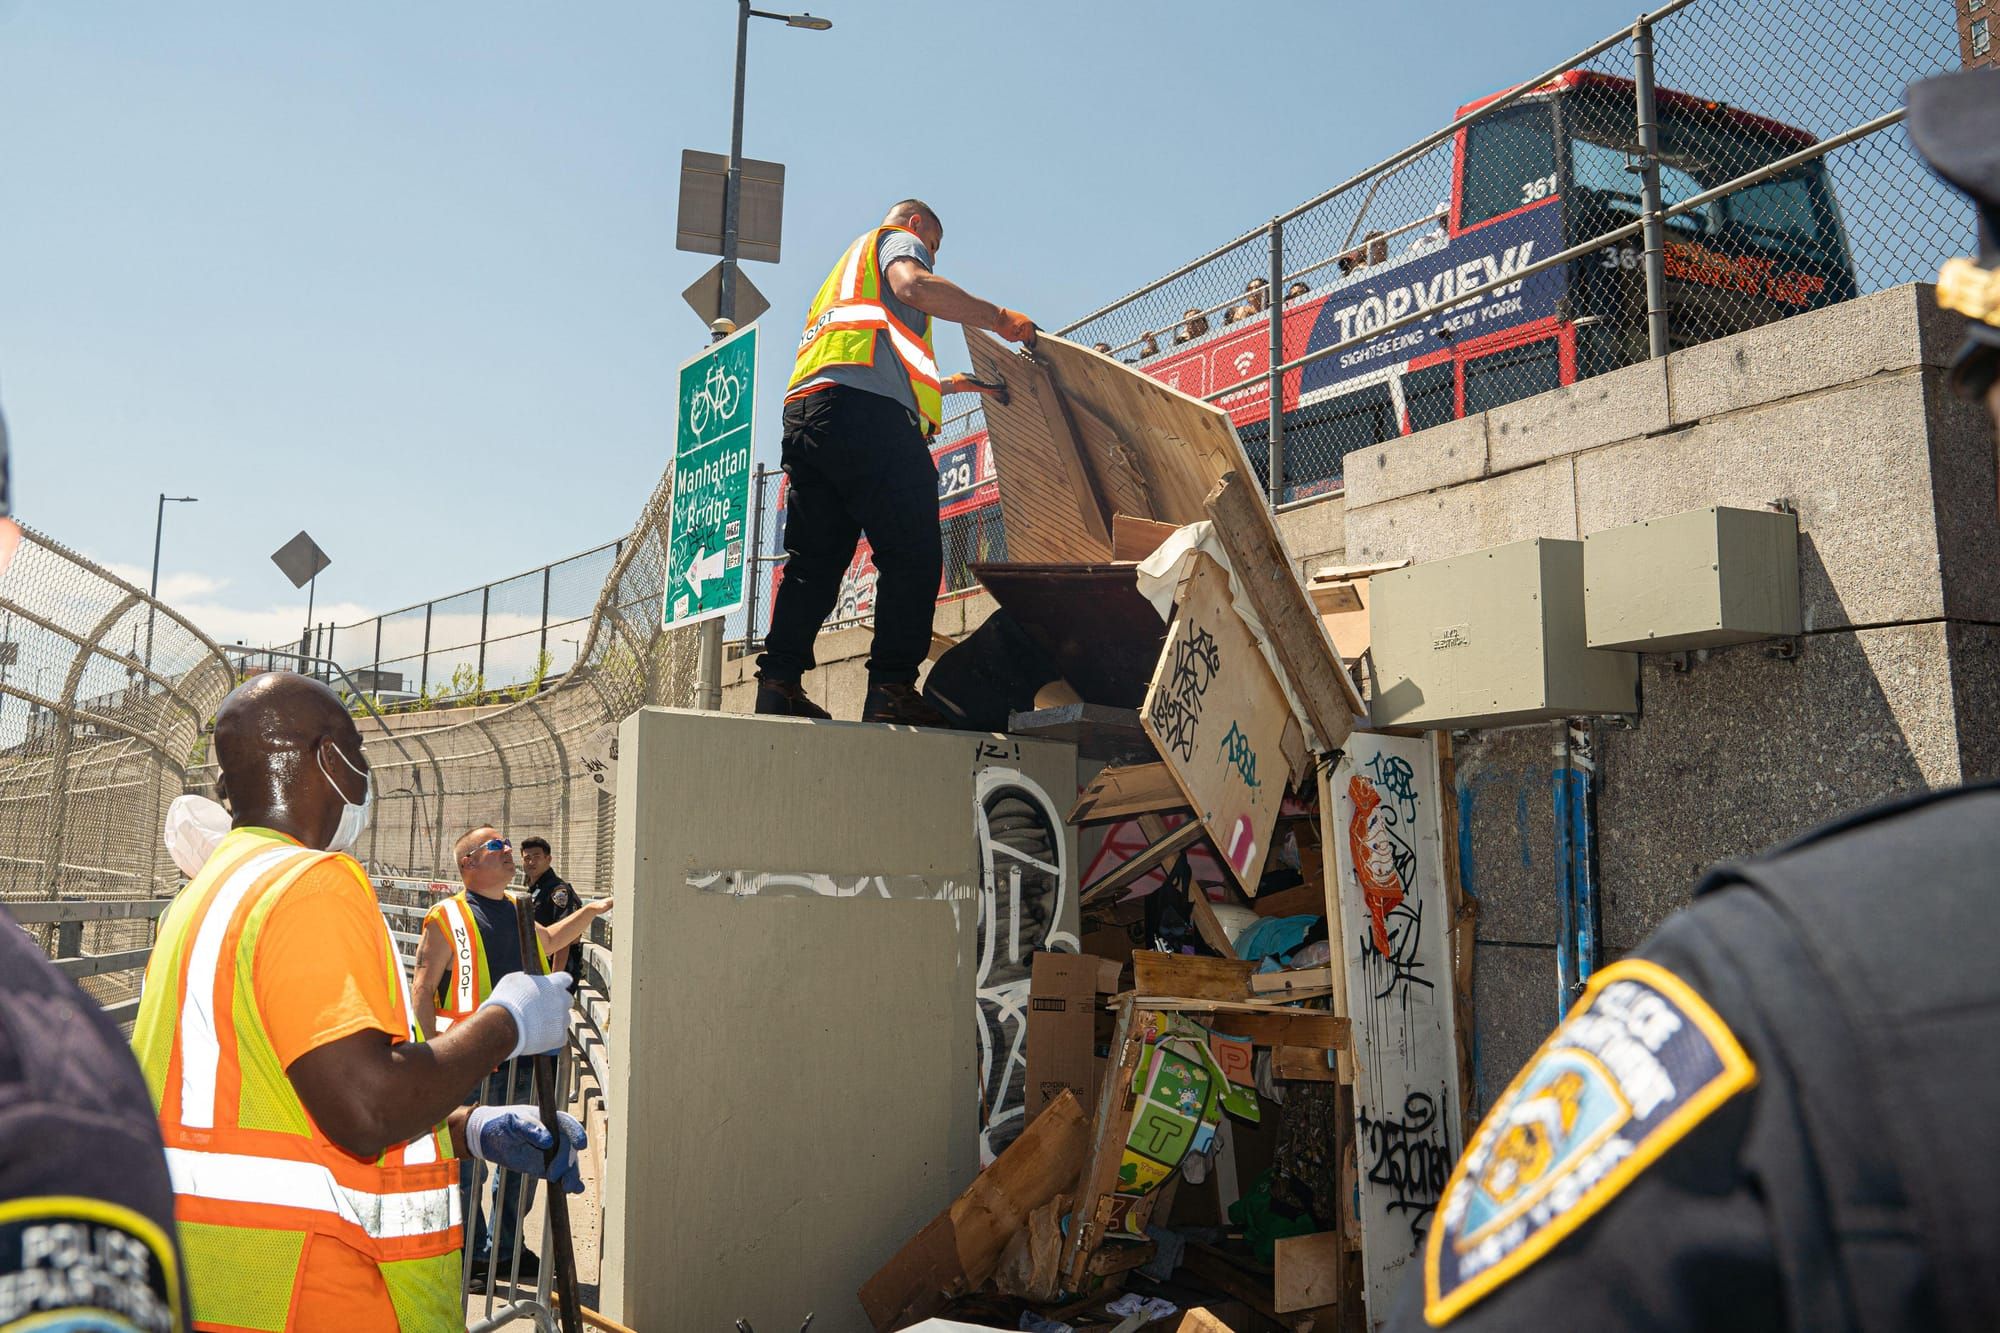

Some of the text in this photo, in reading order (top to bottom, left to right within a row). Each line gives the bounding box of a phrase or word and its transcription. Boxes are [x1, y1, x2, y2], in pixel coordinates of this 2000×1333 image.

[1522, 172, 1558, 204] 361
[1333, 240, 1535, 344] TOPVIEW
[1340, 328, 1425, 369] SIGHTSEEING
[1442, 310, 1479, 334] NEW
[1481, 297, 1523, 326] YORK
[677, 448, 747, 497] Manhattan
[940, 462, 971, 495] $29
[687, 497, 731, 533] Bridge
[454, 927, 471, 997] NYC DOT
[1218, 1043, 1249, 1075] P
[1150, 1115, 1182, 1154] T
